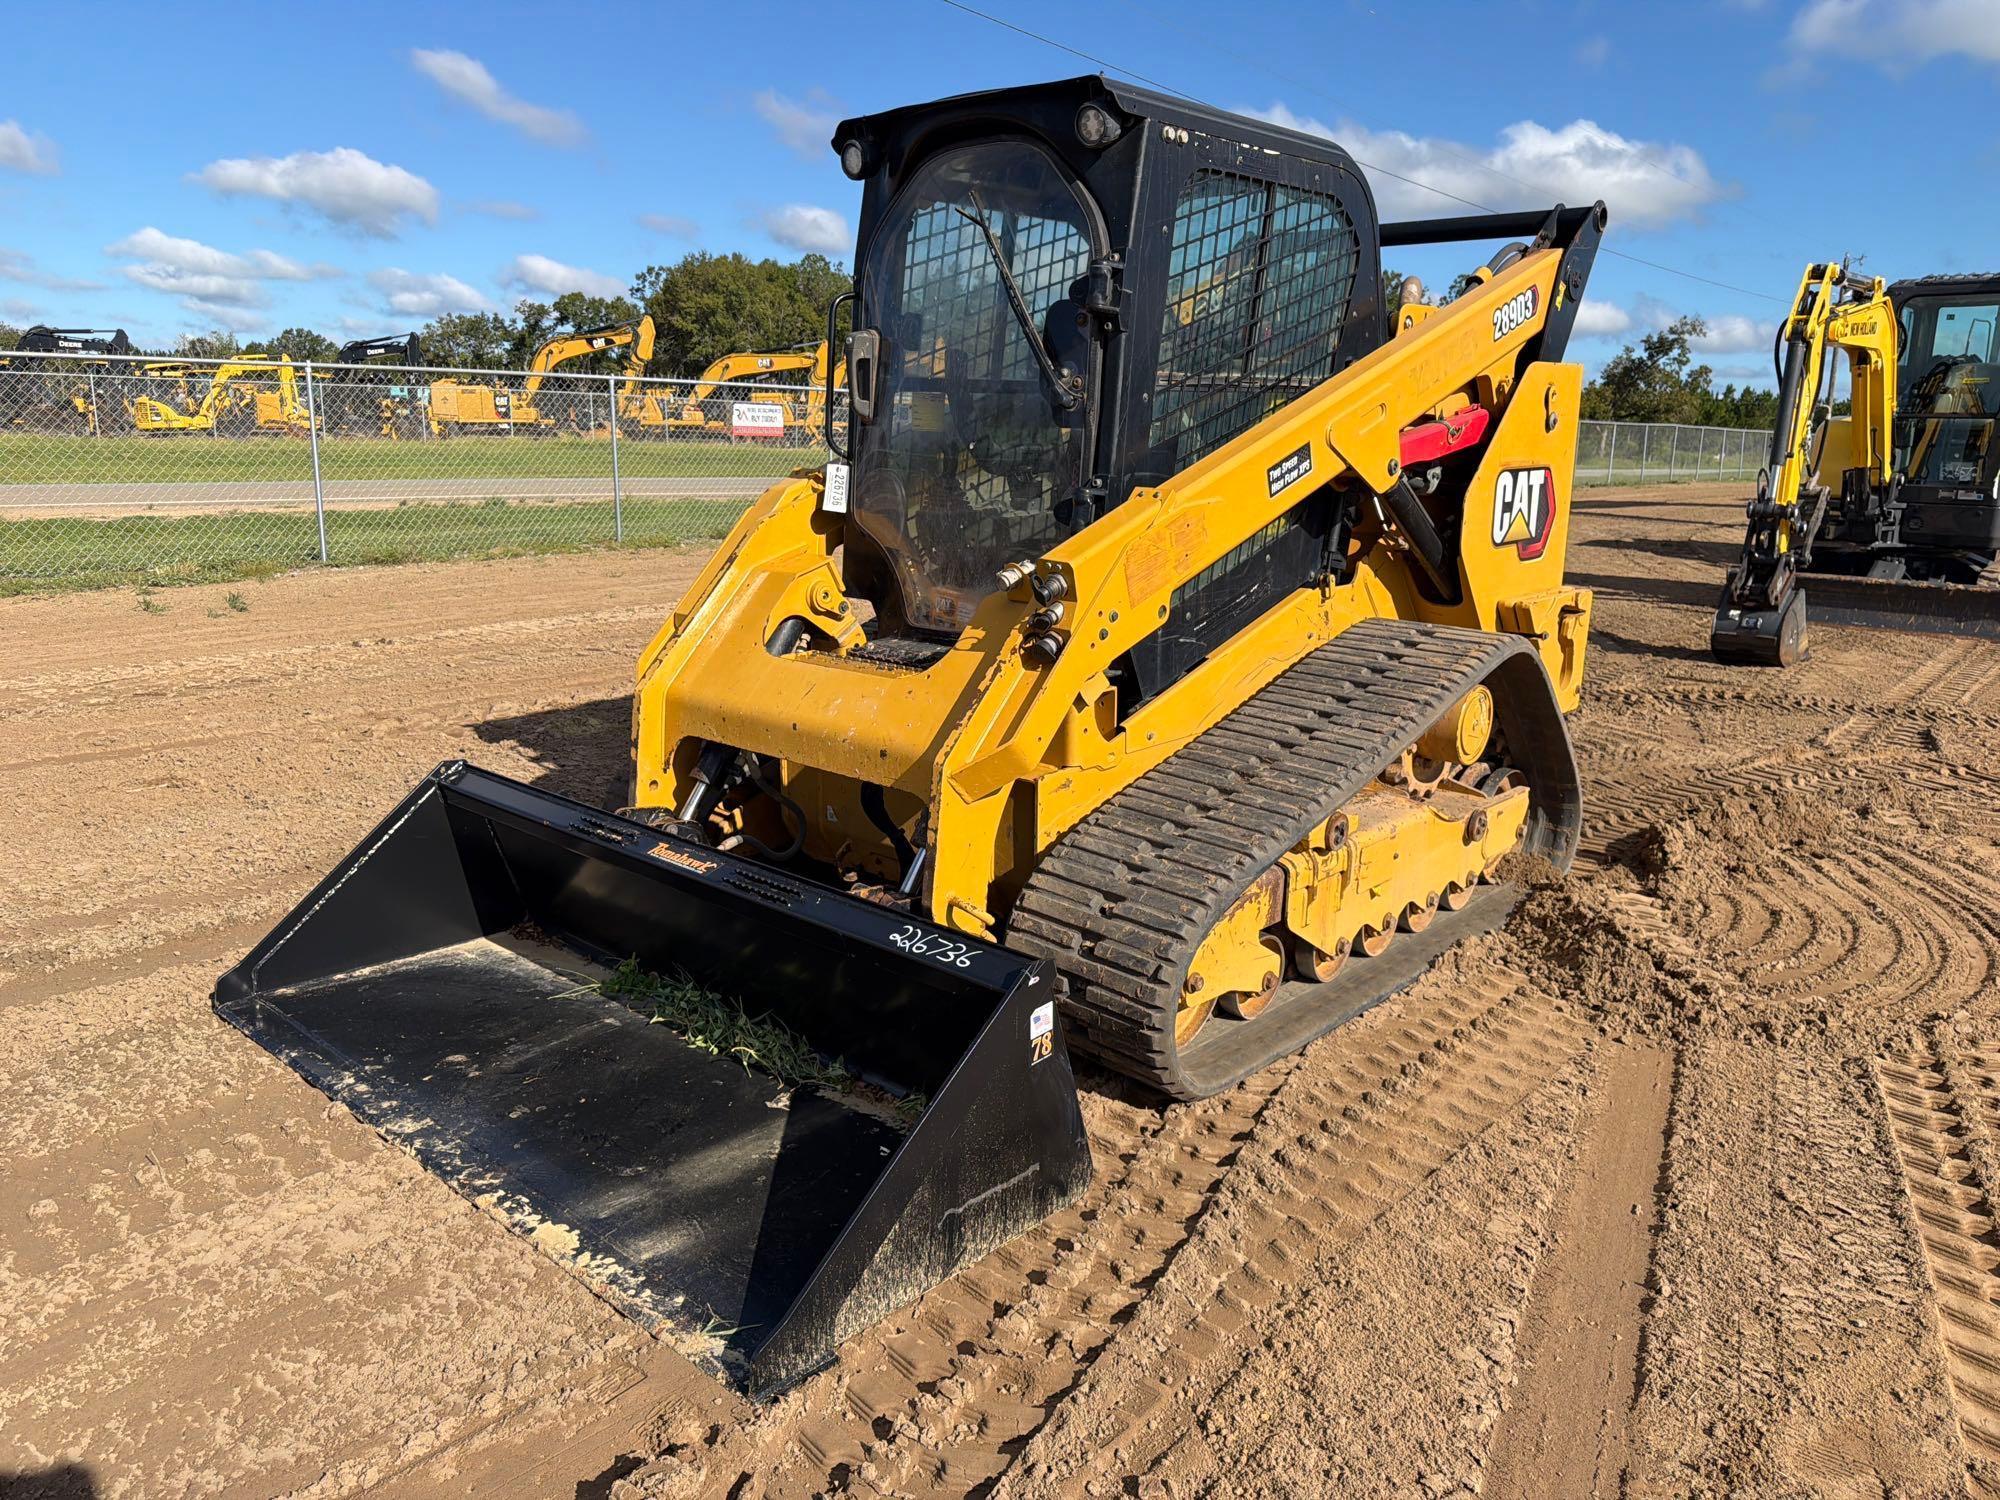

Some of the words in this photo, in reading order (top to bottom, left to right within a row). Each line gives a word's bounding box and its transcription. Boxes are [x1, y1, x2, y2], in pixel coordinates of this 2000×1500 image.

[1493, 289, 1533, 341] 289D3
[59, 340, 82, 348] DEERE
[366, 347, 385, 356] DEERE
[592, 337, 605, 349] CAT
[757, 358, 771, 368] CAT
[1271, 478, 1284, 494] HIGH
[1284, 468, 1299, 485] FLOW
[1299, 459, 1310, 475] XPS
[1281, 455, 1298, 473] SPEED
[832, 474, 845, 506] 226736
[1492, 469, 1546, 544] CAT
[647, 842, 717, 873] Tomahawk
[889, 925, 984, 967] 226736
[1031, 1031, 1053, 1062] 78
